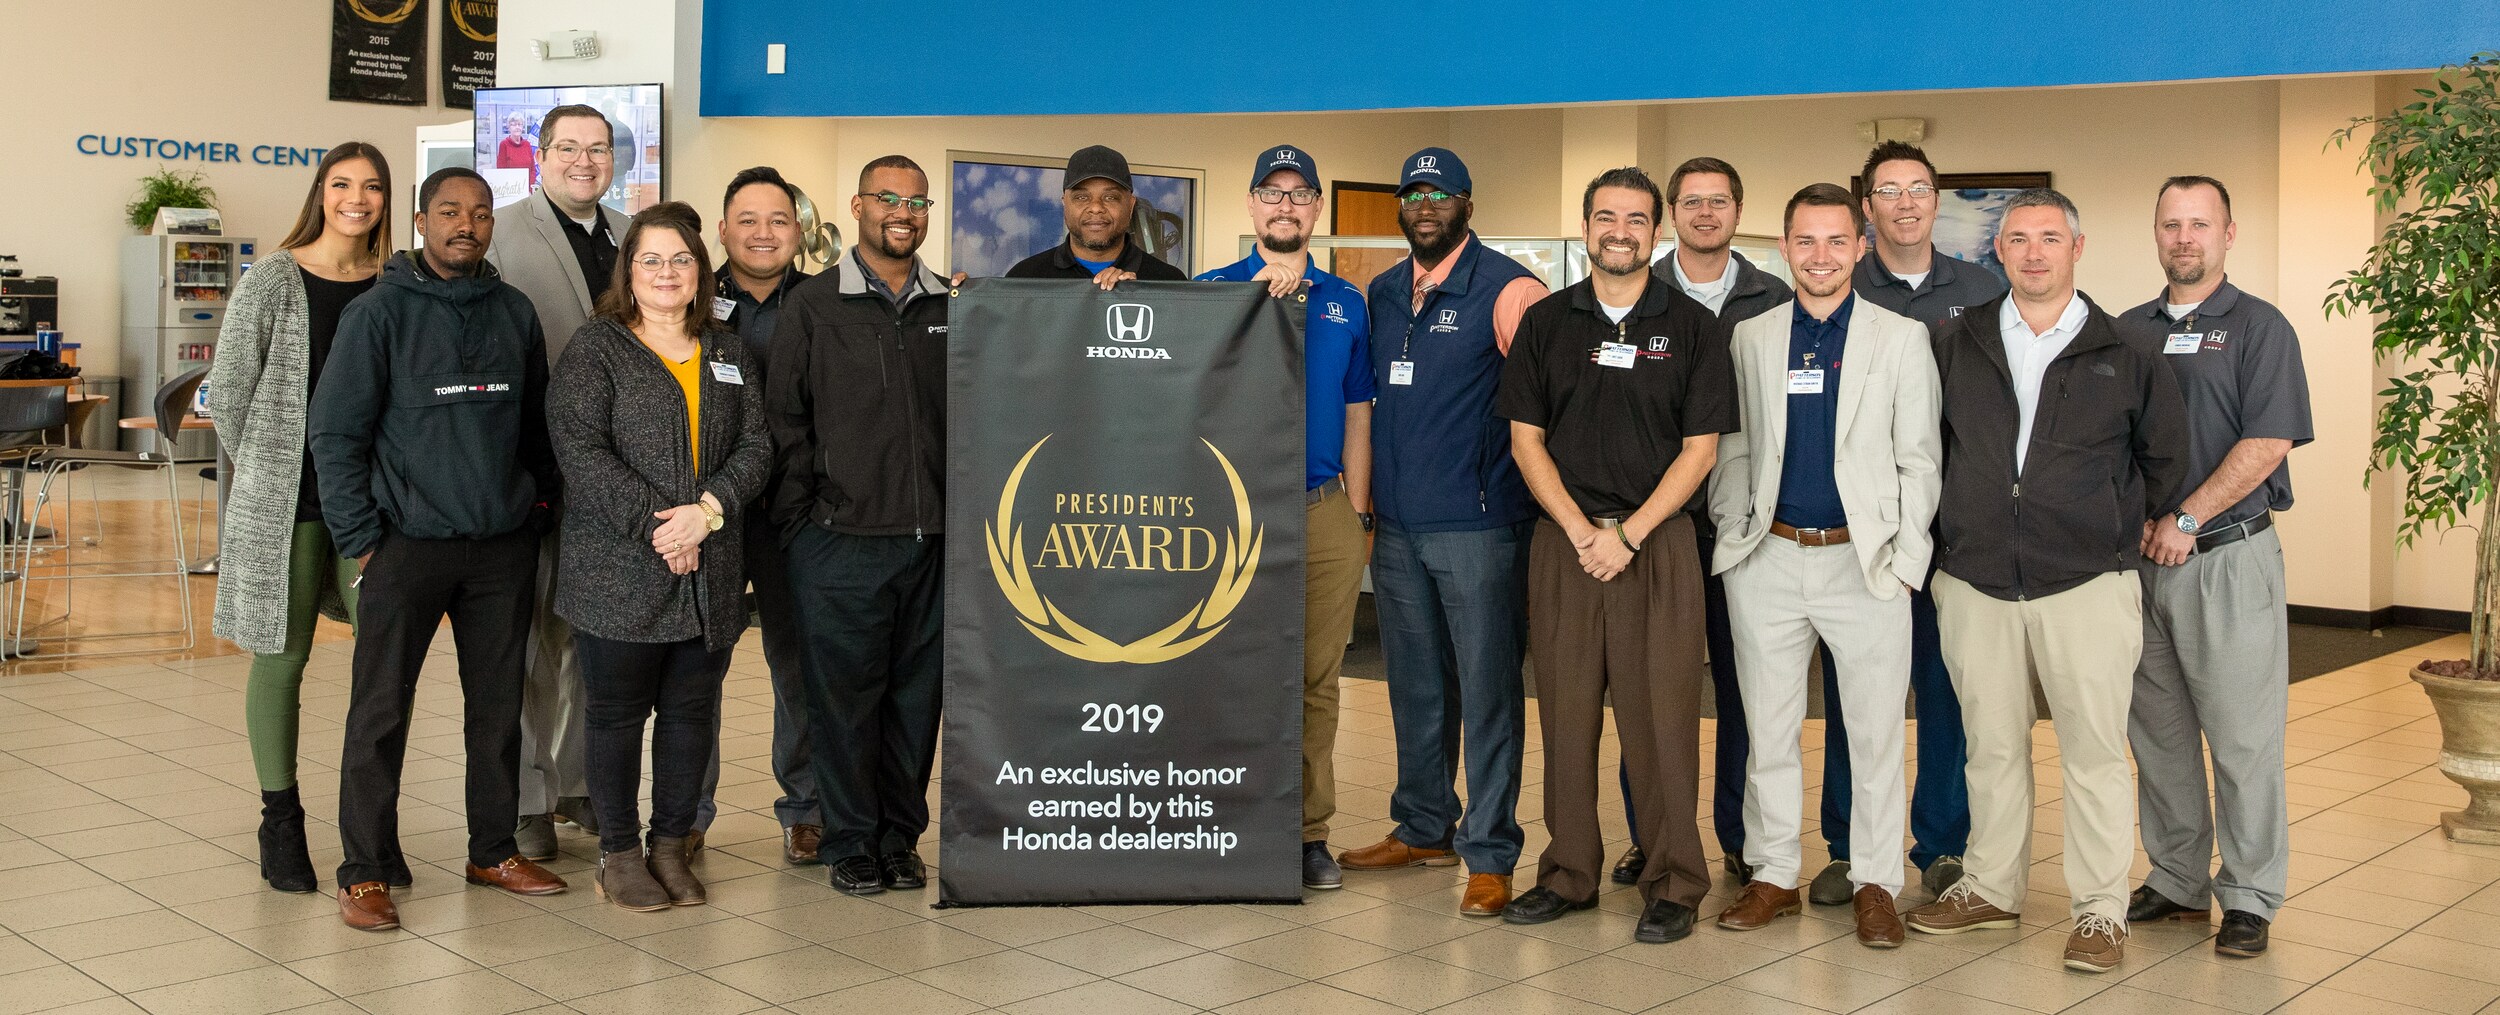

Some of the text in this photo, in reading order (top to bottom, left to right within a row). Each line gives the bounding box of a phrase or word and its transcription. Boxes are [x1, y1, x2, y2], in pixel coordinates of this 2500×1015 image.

[464, 2, 497, 17] AWAR
[369, 35, 390, 46] 2015
[348, 49, 411, 63] An exclusive honor
[473, 50, 495, 61] 2017
[356, 60, 379, 68] earned
[380, 62, 389, 70] by
[451, 64, 462, 73] An
[462, 66, 494, 76] exclusive
[350, 67, 408, 80] Honda dealership
[453, 82, 476, 91] Honda
[459, 75, 484, 84] earned
[484, 76, 494, 86] by
[76, 134, 329, 167] CUSTOMER CENT
[1270, 159, 1301, 168] HONDA
[1410, 168, 1441, 177] HONDA
[1086, 346, 1172, 360] HONDA
[434, 383, 510, 396] TOMMY JEANS
[1056, 493, 1194, 517] PRESIDENT'S
[1032, 522, 1218, 572] AWARD
[1081, 702, 1164, 733] 2019
[996, 760, 1247, 786] An exclusive honor
[1028, 793, 1214, 825] earned by this
[1002, 824, 1238, 857] Honda dealership
